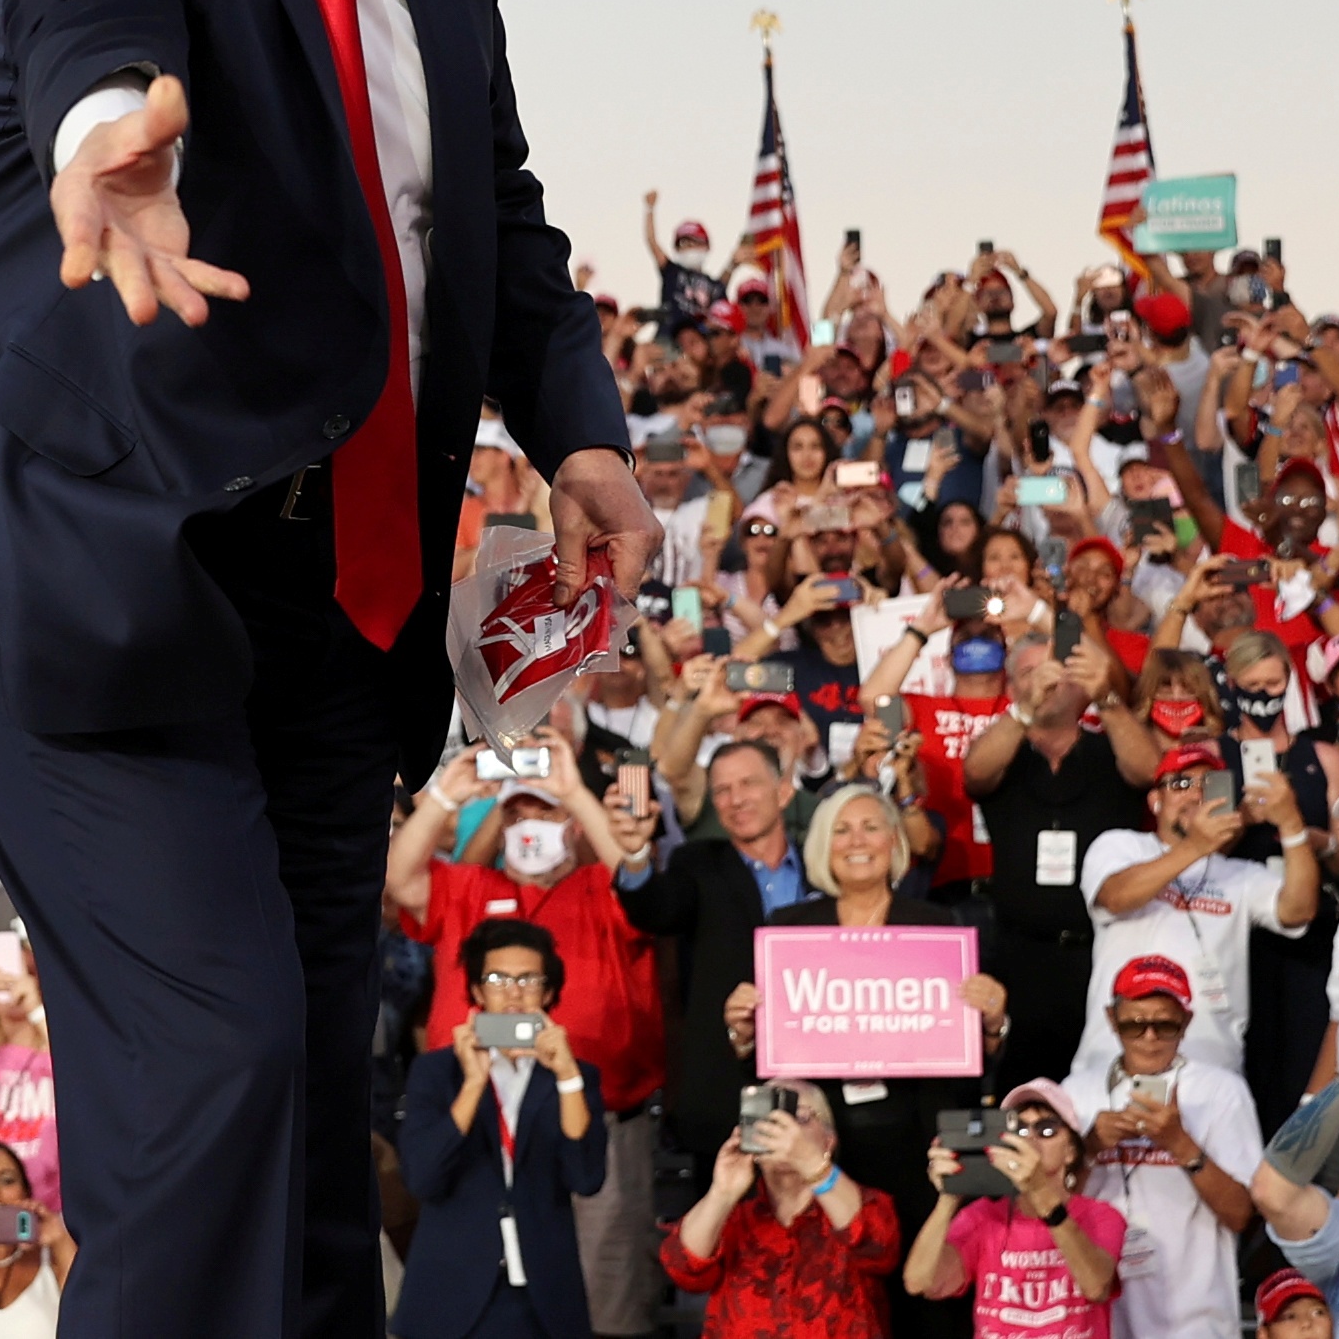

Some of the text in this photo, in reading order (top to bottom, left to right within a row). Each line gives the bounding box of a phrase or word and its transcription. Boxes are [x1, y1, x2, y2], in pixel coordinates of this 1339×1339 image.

[782, 967, 950, 1013] Women
[801, 1014, 937, 1034] FOR TRUMP
[1000, 1248, 1067, 1270] WOME
[982, 1272, 1084, 1310] TRUM
